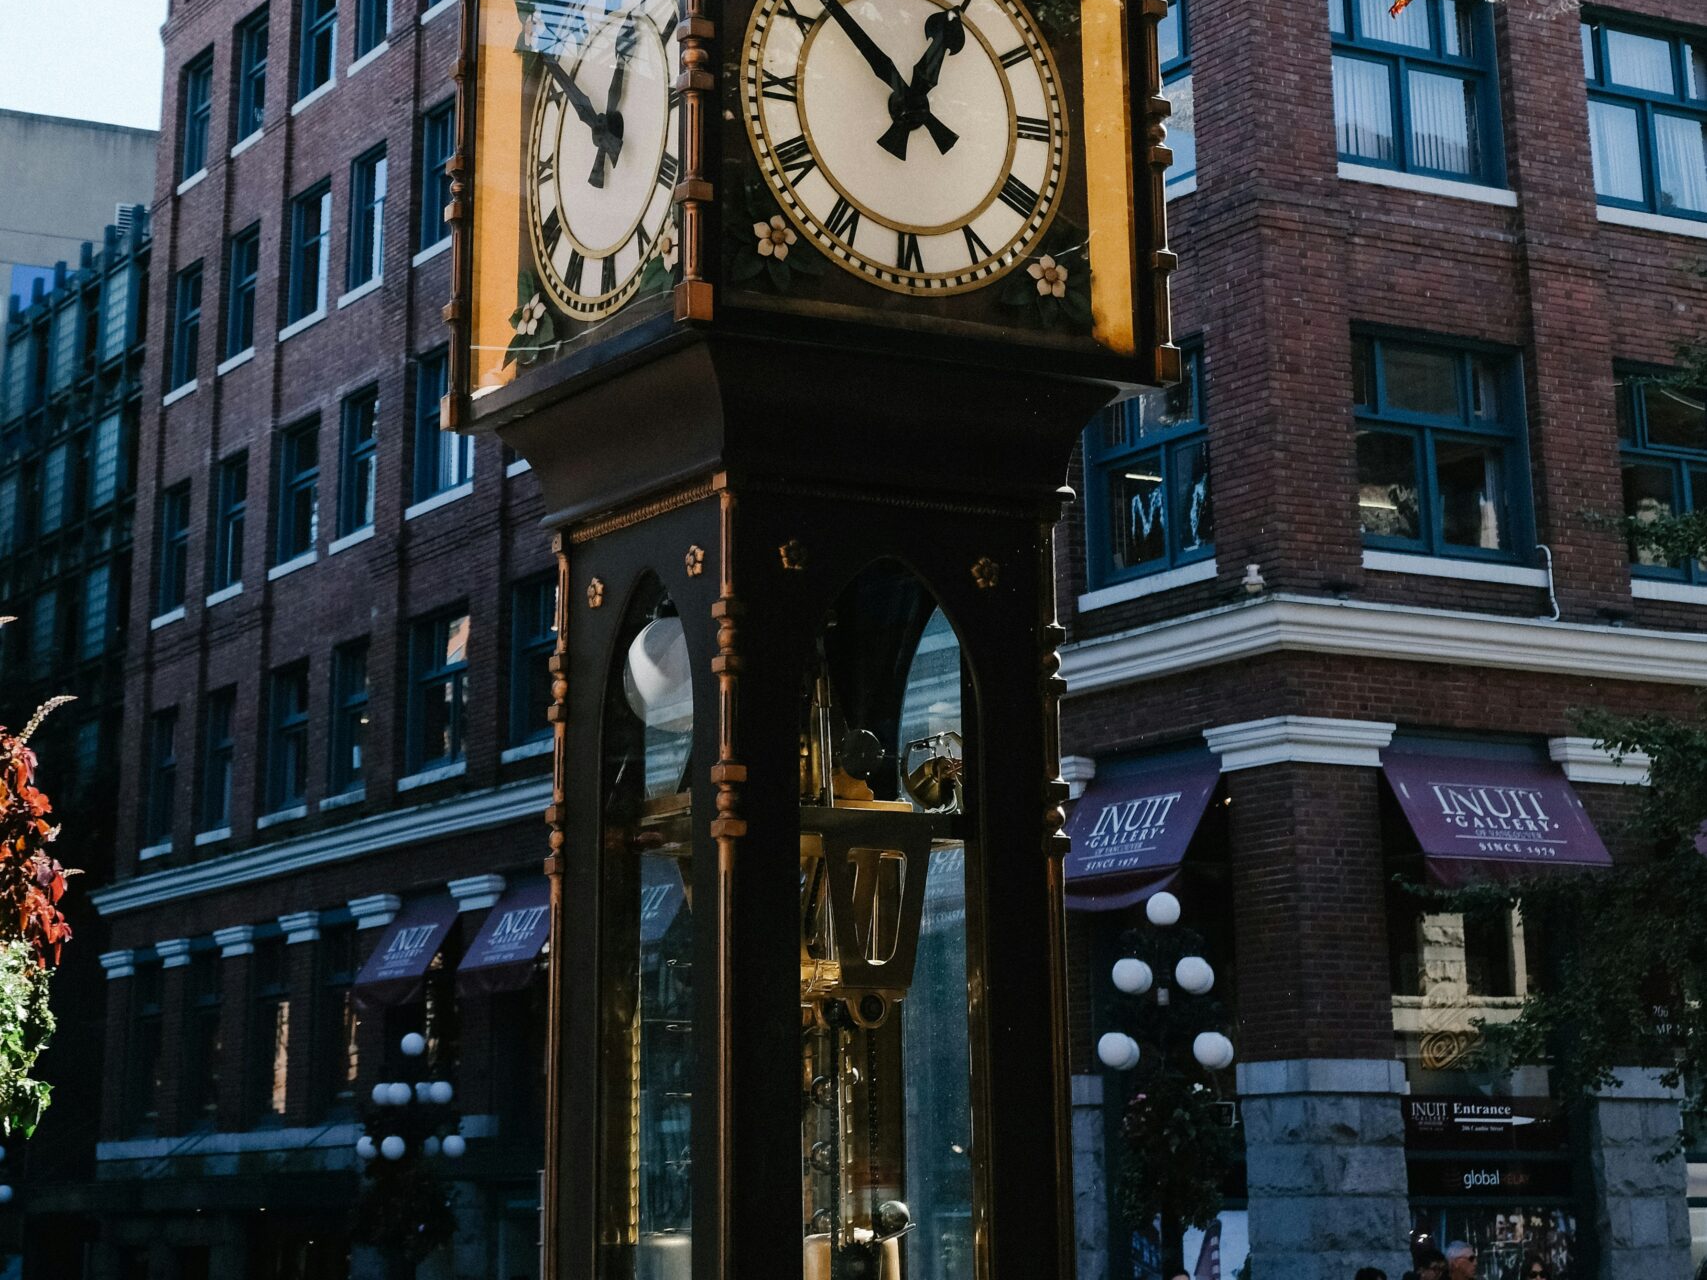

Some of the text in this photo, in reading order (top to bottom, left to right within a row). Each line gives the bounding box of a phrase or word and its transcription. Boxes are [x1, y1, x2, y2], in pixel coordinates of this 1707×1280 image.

[999, 44, 1031, 69] II
[761, 70, 797, 103] IX
[1016, 116, 1050, 142] III
[773, 134, 817, 192] VIII
[824, 196, 860, 251] VII
[898, 232, 925, 274] VI
[962, 225, 994, 265] V
[1089, 793, 1182, 837] INUIT
[1432, 785, 1549, 820] INUIT
[1455, 816, 1550, 831] GALLERY
[1090, 828, 1158, 848] GALLERY
[1479, 842, 1555, 856] SINCE 1979
[1086, 859, 1115, 871] SINCE
[492, 905, 549, 937] INUIT
[388, 924, 439, 952] INUIT
[1412, 1102, 1511, 1117] INUIT Entrance
[1463, 1169, 1500, 1189] global
